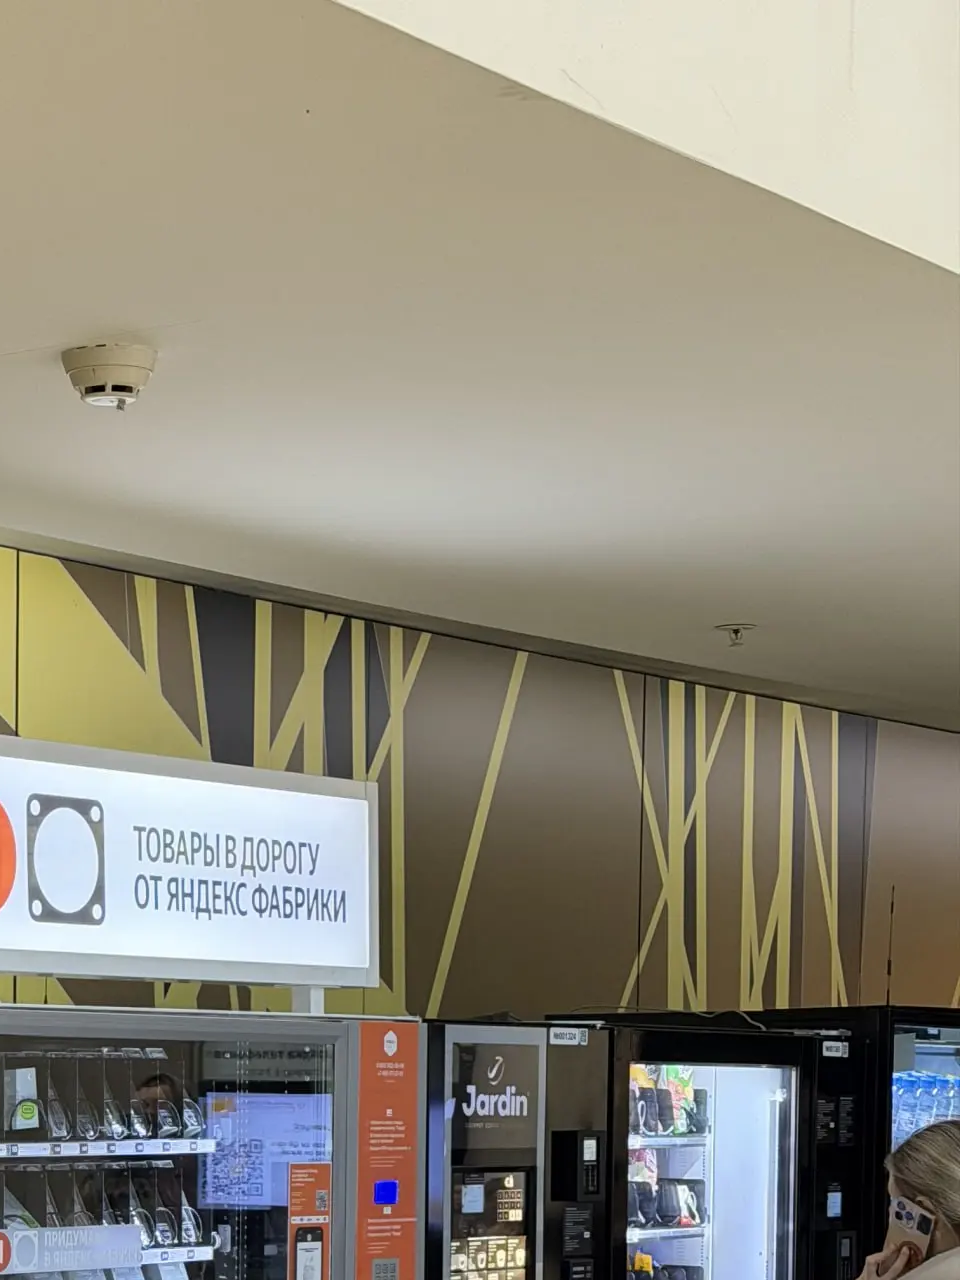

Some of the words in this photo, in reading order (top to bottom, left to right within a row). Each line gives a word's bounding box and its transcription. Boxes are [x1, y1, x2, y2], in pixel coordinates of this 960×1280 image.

[132, 825, 220, 868] ТОВАРЫ
[225, 834, 237, 869] В
[240, 836, 320, 878] ДОРОГУ
[134, 873, 163, 910] ОТ
[166, 876, 248, 921] ЯНДЕКС
[251, 883, 347, 923] ФАБРИКИ
[461, 1085, 528, 1117] Jardin
